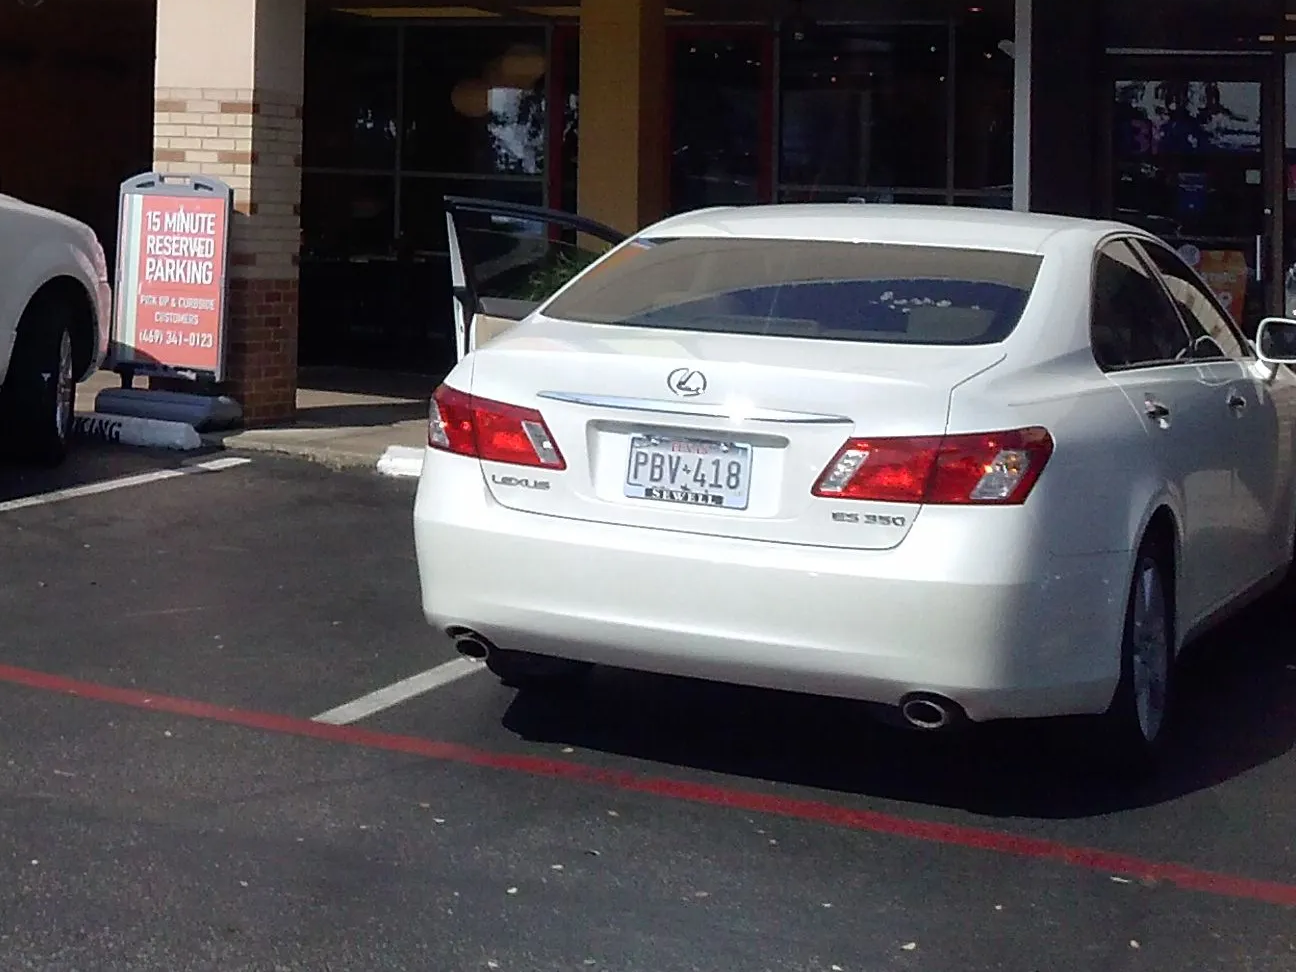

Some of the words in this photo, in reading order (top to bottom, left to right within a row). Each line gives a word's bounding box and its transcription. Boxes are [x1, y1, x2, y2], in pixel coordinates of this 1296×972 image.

[146, 211, 161, 232] 15
[164, 211, 216, 235] MINUTE
[147, 235, 215, 259] RESERVED
[146, 257, 214, 285] PARKING
[154, 312, 199, 325] CUSTOMERS
[166, 331, 213, 348] 341-0123
[492, 474, 550, 490] LEXUS
[651, 488, 717, 505] SEWELL
[832, 512, 859, 524] ES
[863, 514, 906, 527] 350
